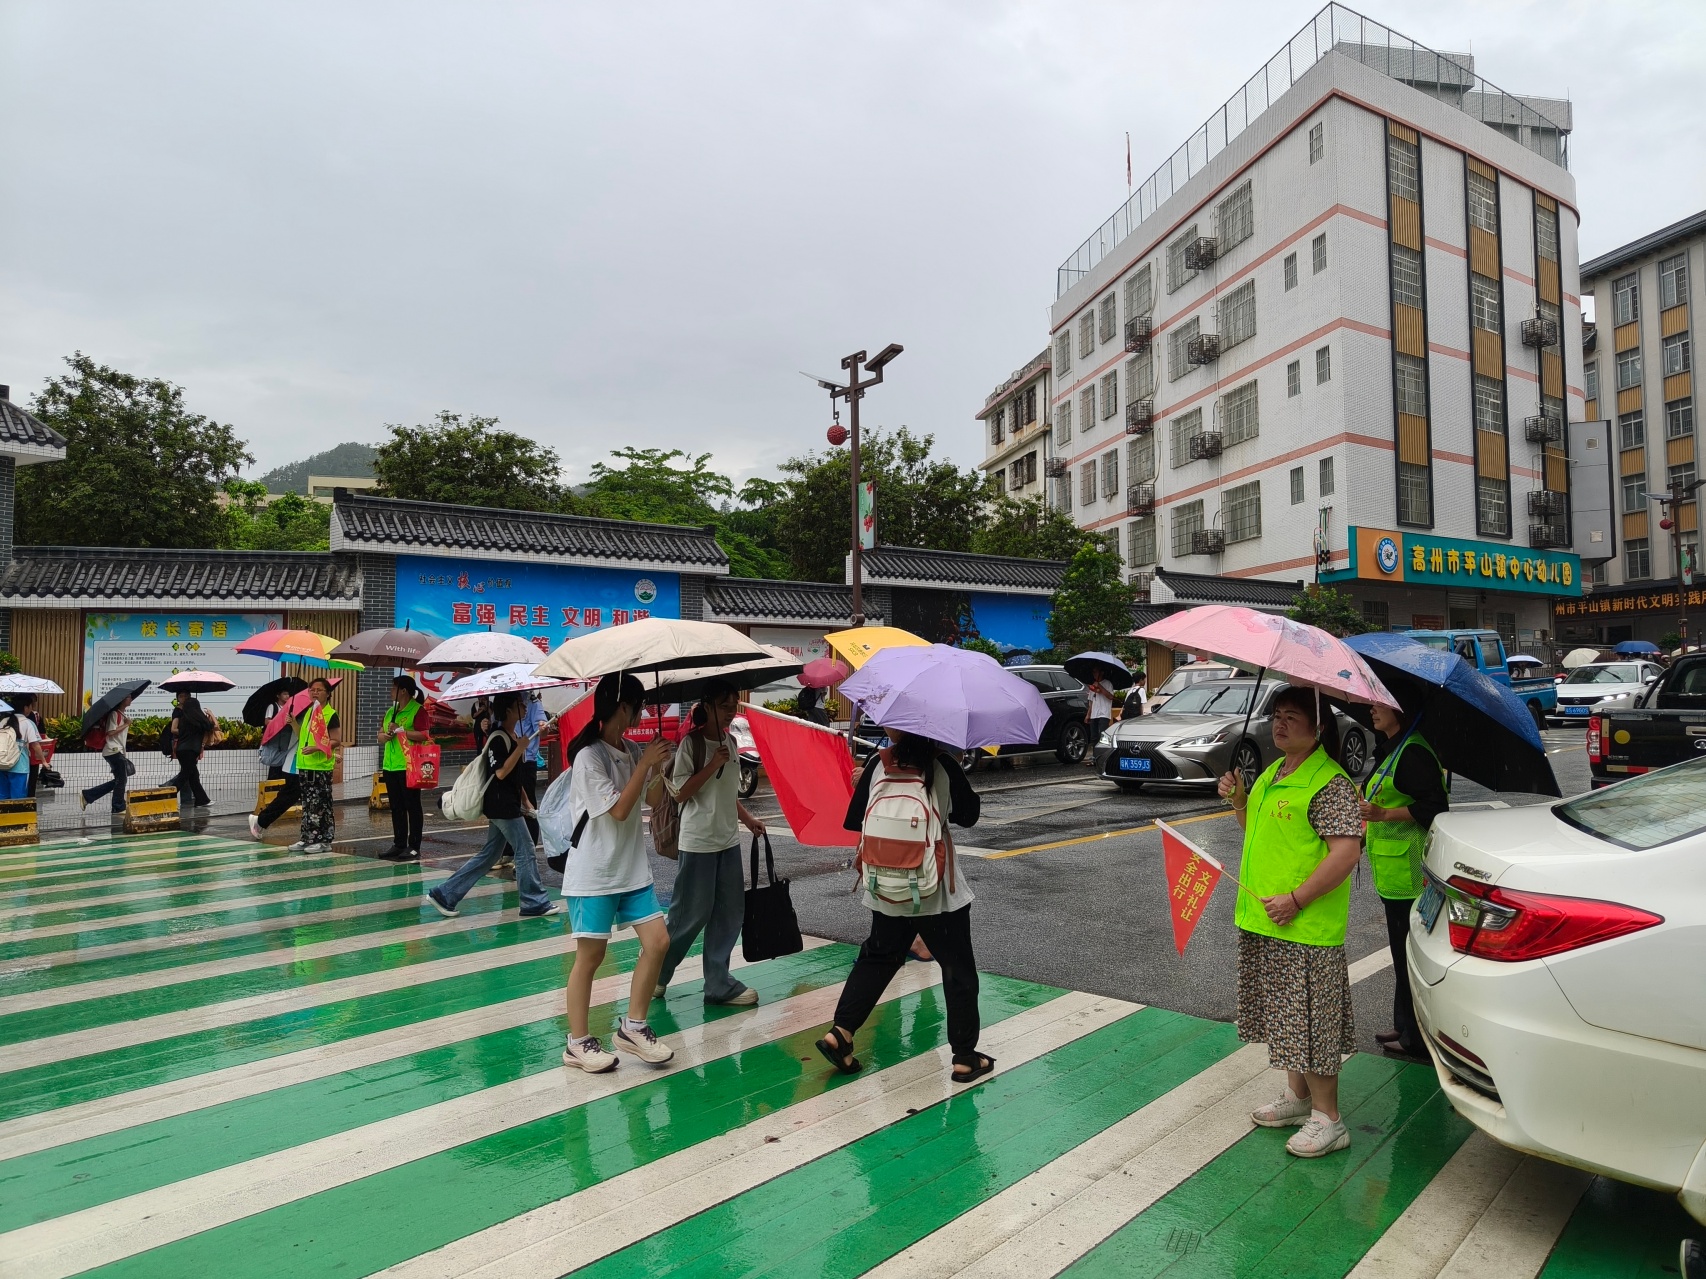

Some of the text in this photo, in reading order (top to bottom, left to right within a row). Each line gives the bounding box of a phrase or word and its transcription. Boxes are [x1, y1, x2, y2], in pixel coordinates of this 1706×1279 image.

[1412, 544, 1572, 586] 高州市平山镇中心幼儿园
[452, 602, 496, 625] 富强
[509, 604, 549, 627] 民主
[561, 606, 602, 628] 文明
[141, 620, 228, 638] 校长寄语
[385, 644, 406, 653] With
[1172, 852, 1203, 900] 安全出行
[1453, 861, 1493, 881] CRIDER
[1180, 870, 1213, 922] 文明礼让
